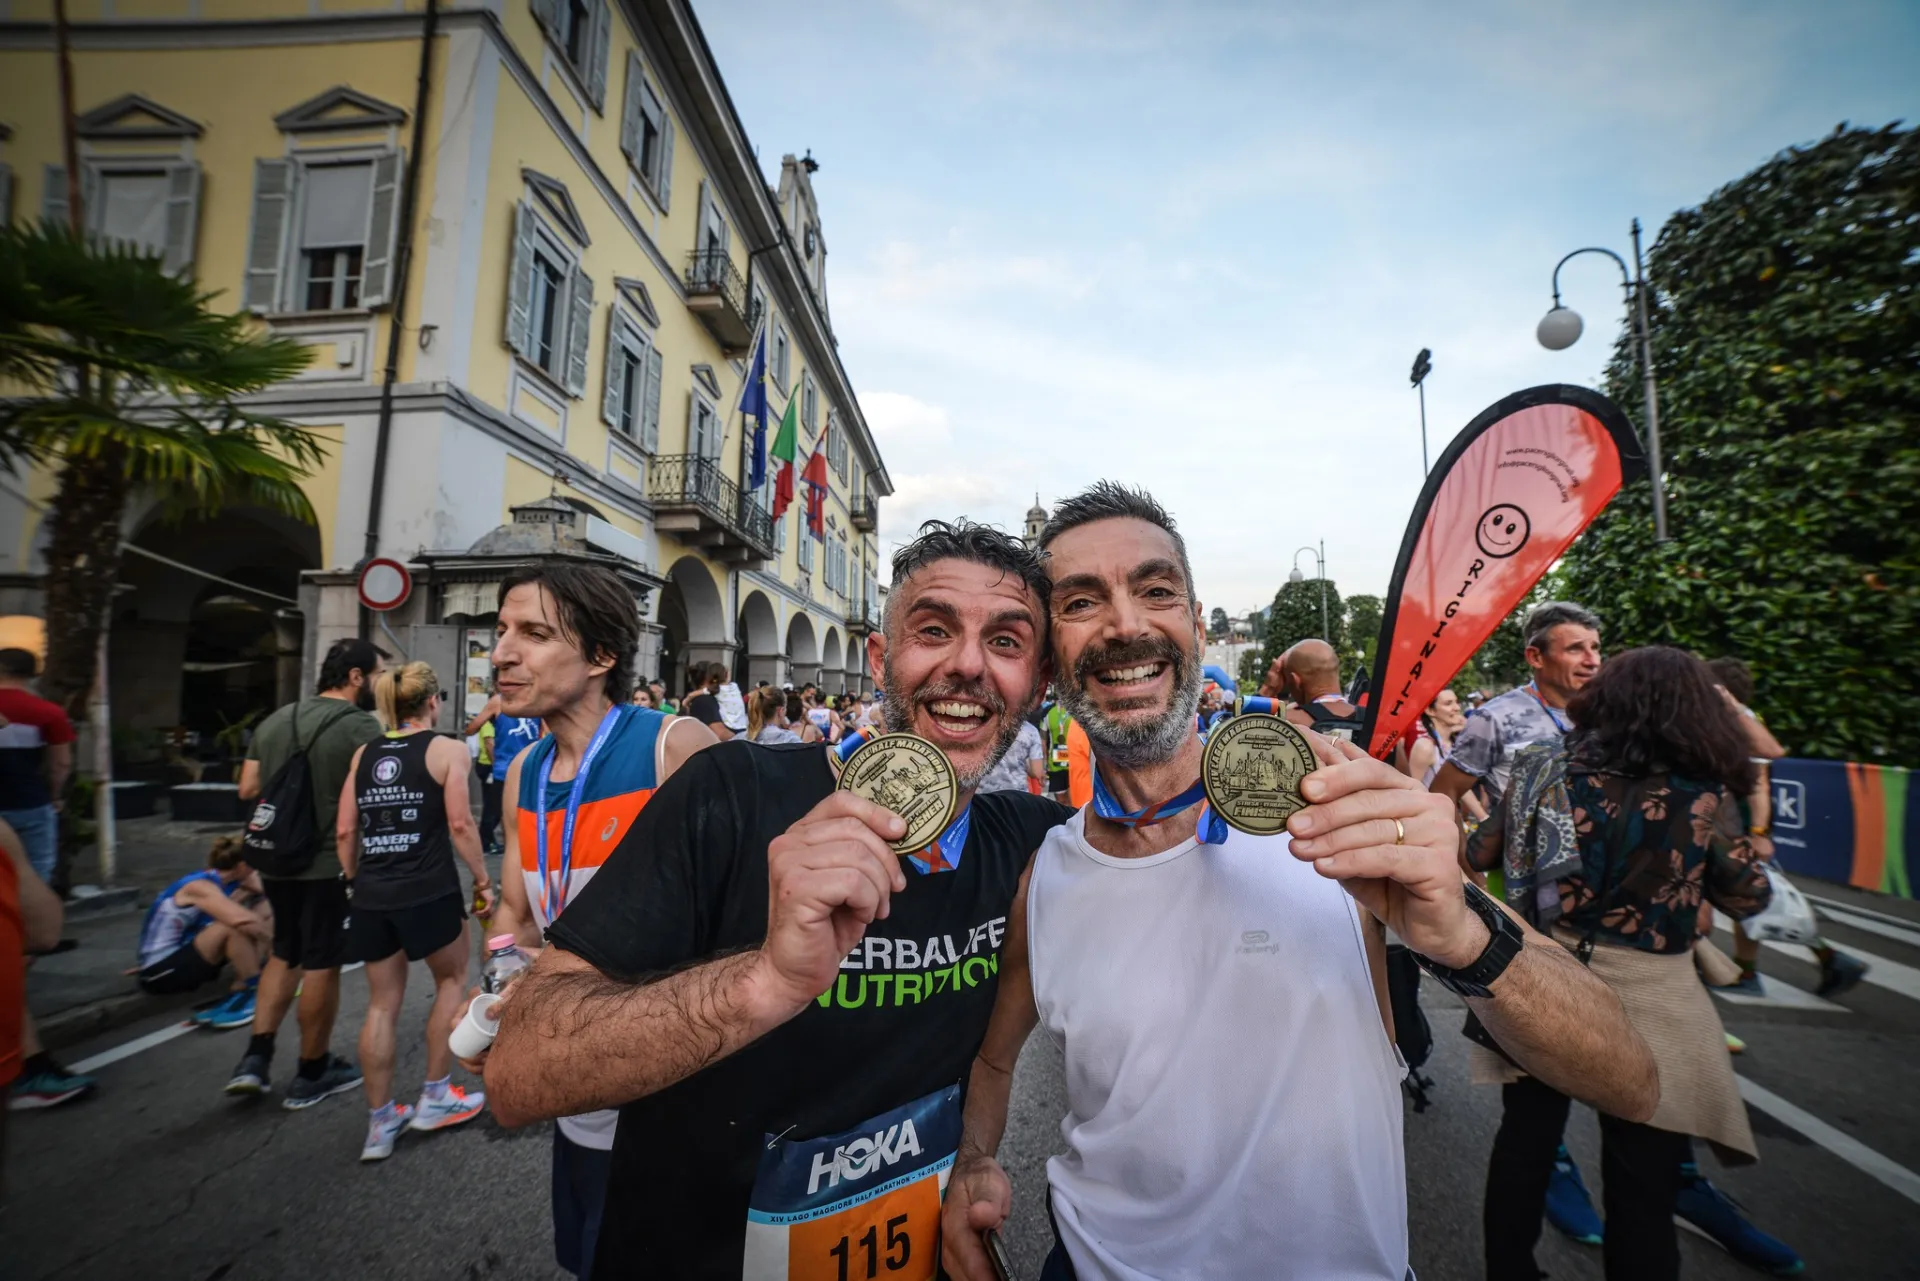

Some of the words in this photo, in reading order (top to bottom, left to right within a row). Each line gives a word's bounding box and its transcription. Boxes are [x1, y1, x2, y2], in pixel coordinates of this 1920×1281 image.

[1221, 719, 1270, 747] MAGGIORE
[1270, 722, 1296, 740] HALF
[872, 740, 895, 755] HALF
[896, 740, 945, 773] MARATHON
[908, 799, 945, 835] NISHER
[1234, 807, 1290, 818] FINISHER
[839, 916, 1006, 970] ERBALIFE
[807, 1117, 922, 1195] HOKA
[770, 1215, 784, 1223] XIV
[787, 1213, 810, 1222] LAGO
[812, 1200, 853, 1217] MAGGIORE
[855, 1191, 873, 1204] HALF
[874, 1176, 911, 1195] MARATHON
[829, 1213, 911, 1281] 115
